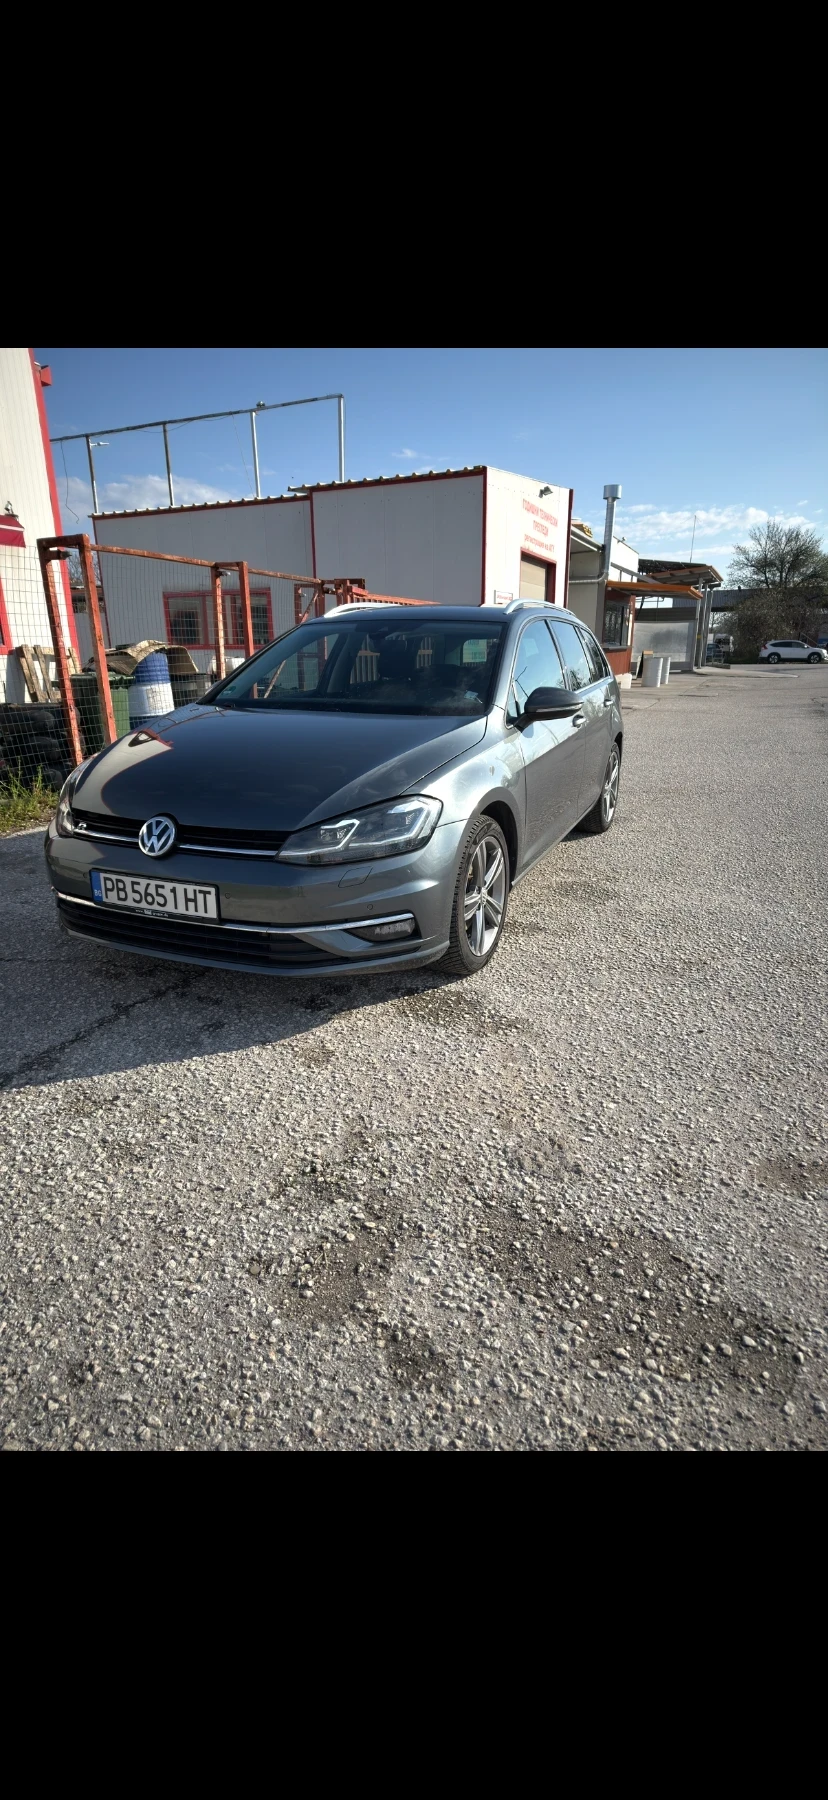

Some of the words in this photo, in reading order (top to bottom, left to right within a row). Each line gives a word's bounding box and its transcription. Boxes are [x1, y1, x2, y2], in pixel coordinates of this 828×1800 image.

[139, 816, 175, 856] VW
[94, 889, 102, 897] BG
[103, 876, 128, 902] PB
[131, 880, 178, 910] 5651
[183, 887, 212, 914] HT
